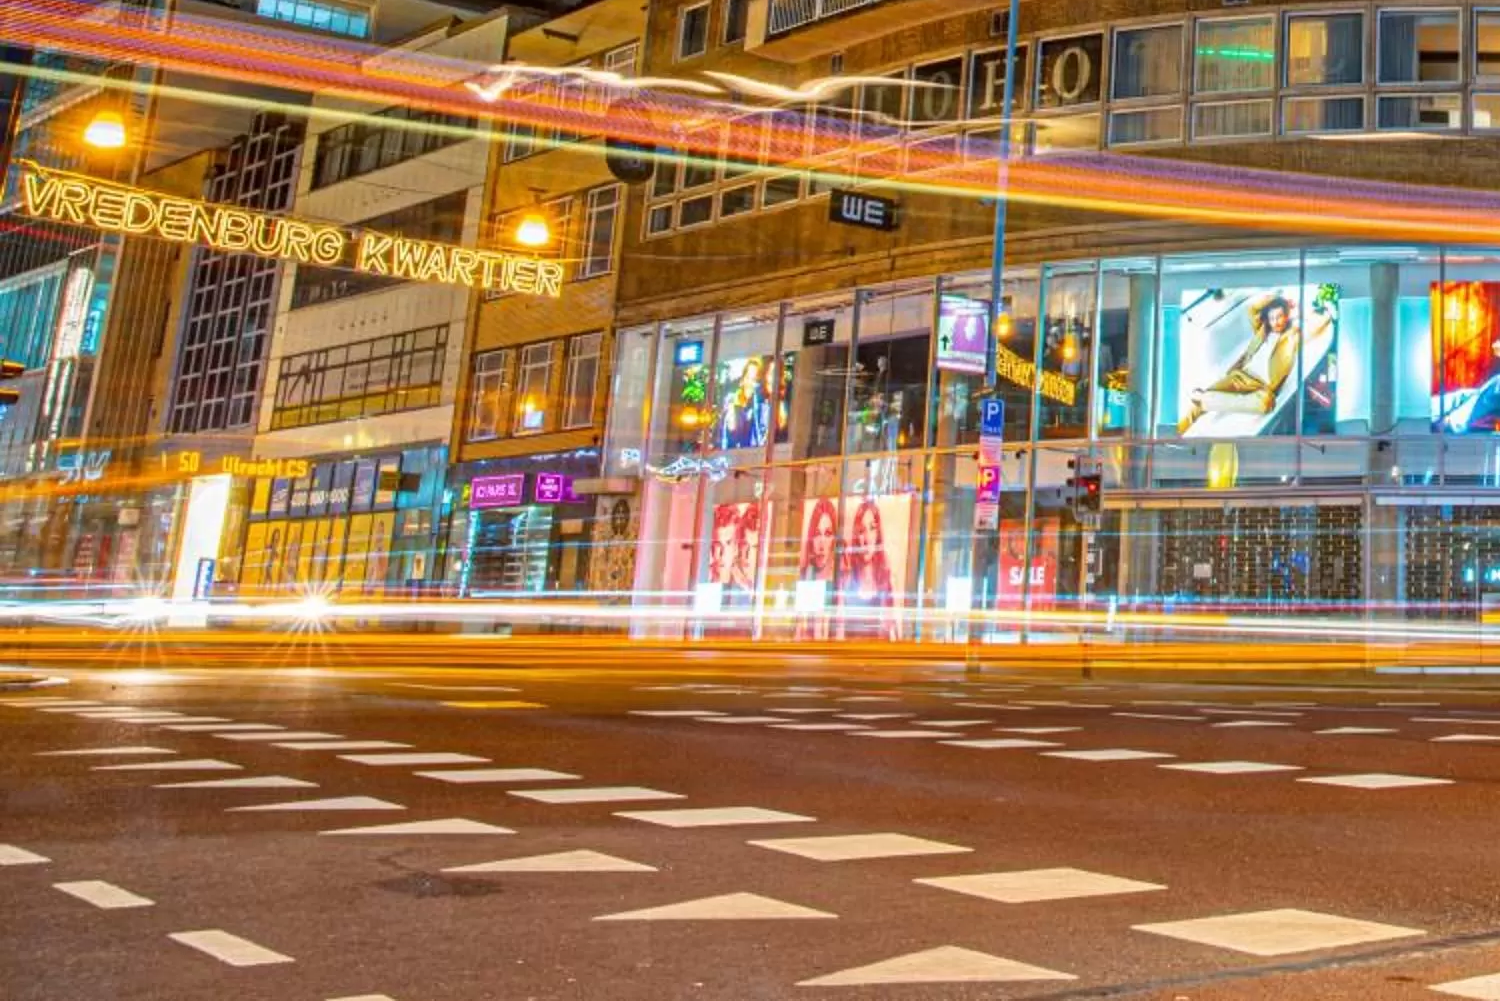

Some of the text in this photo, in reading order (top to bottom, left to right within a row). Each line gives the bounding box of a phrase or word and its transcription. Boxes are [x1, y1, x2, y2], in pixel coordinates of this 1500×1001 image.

[841, 195, 885, 226] WE
[23, 174, 564, 297] VREDENBURG KWARTIER
[986, 401, 1000, 422] P
